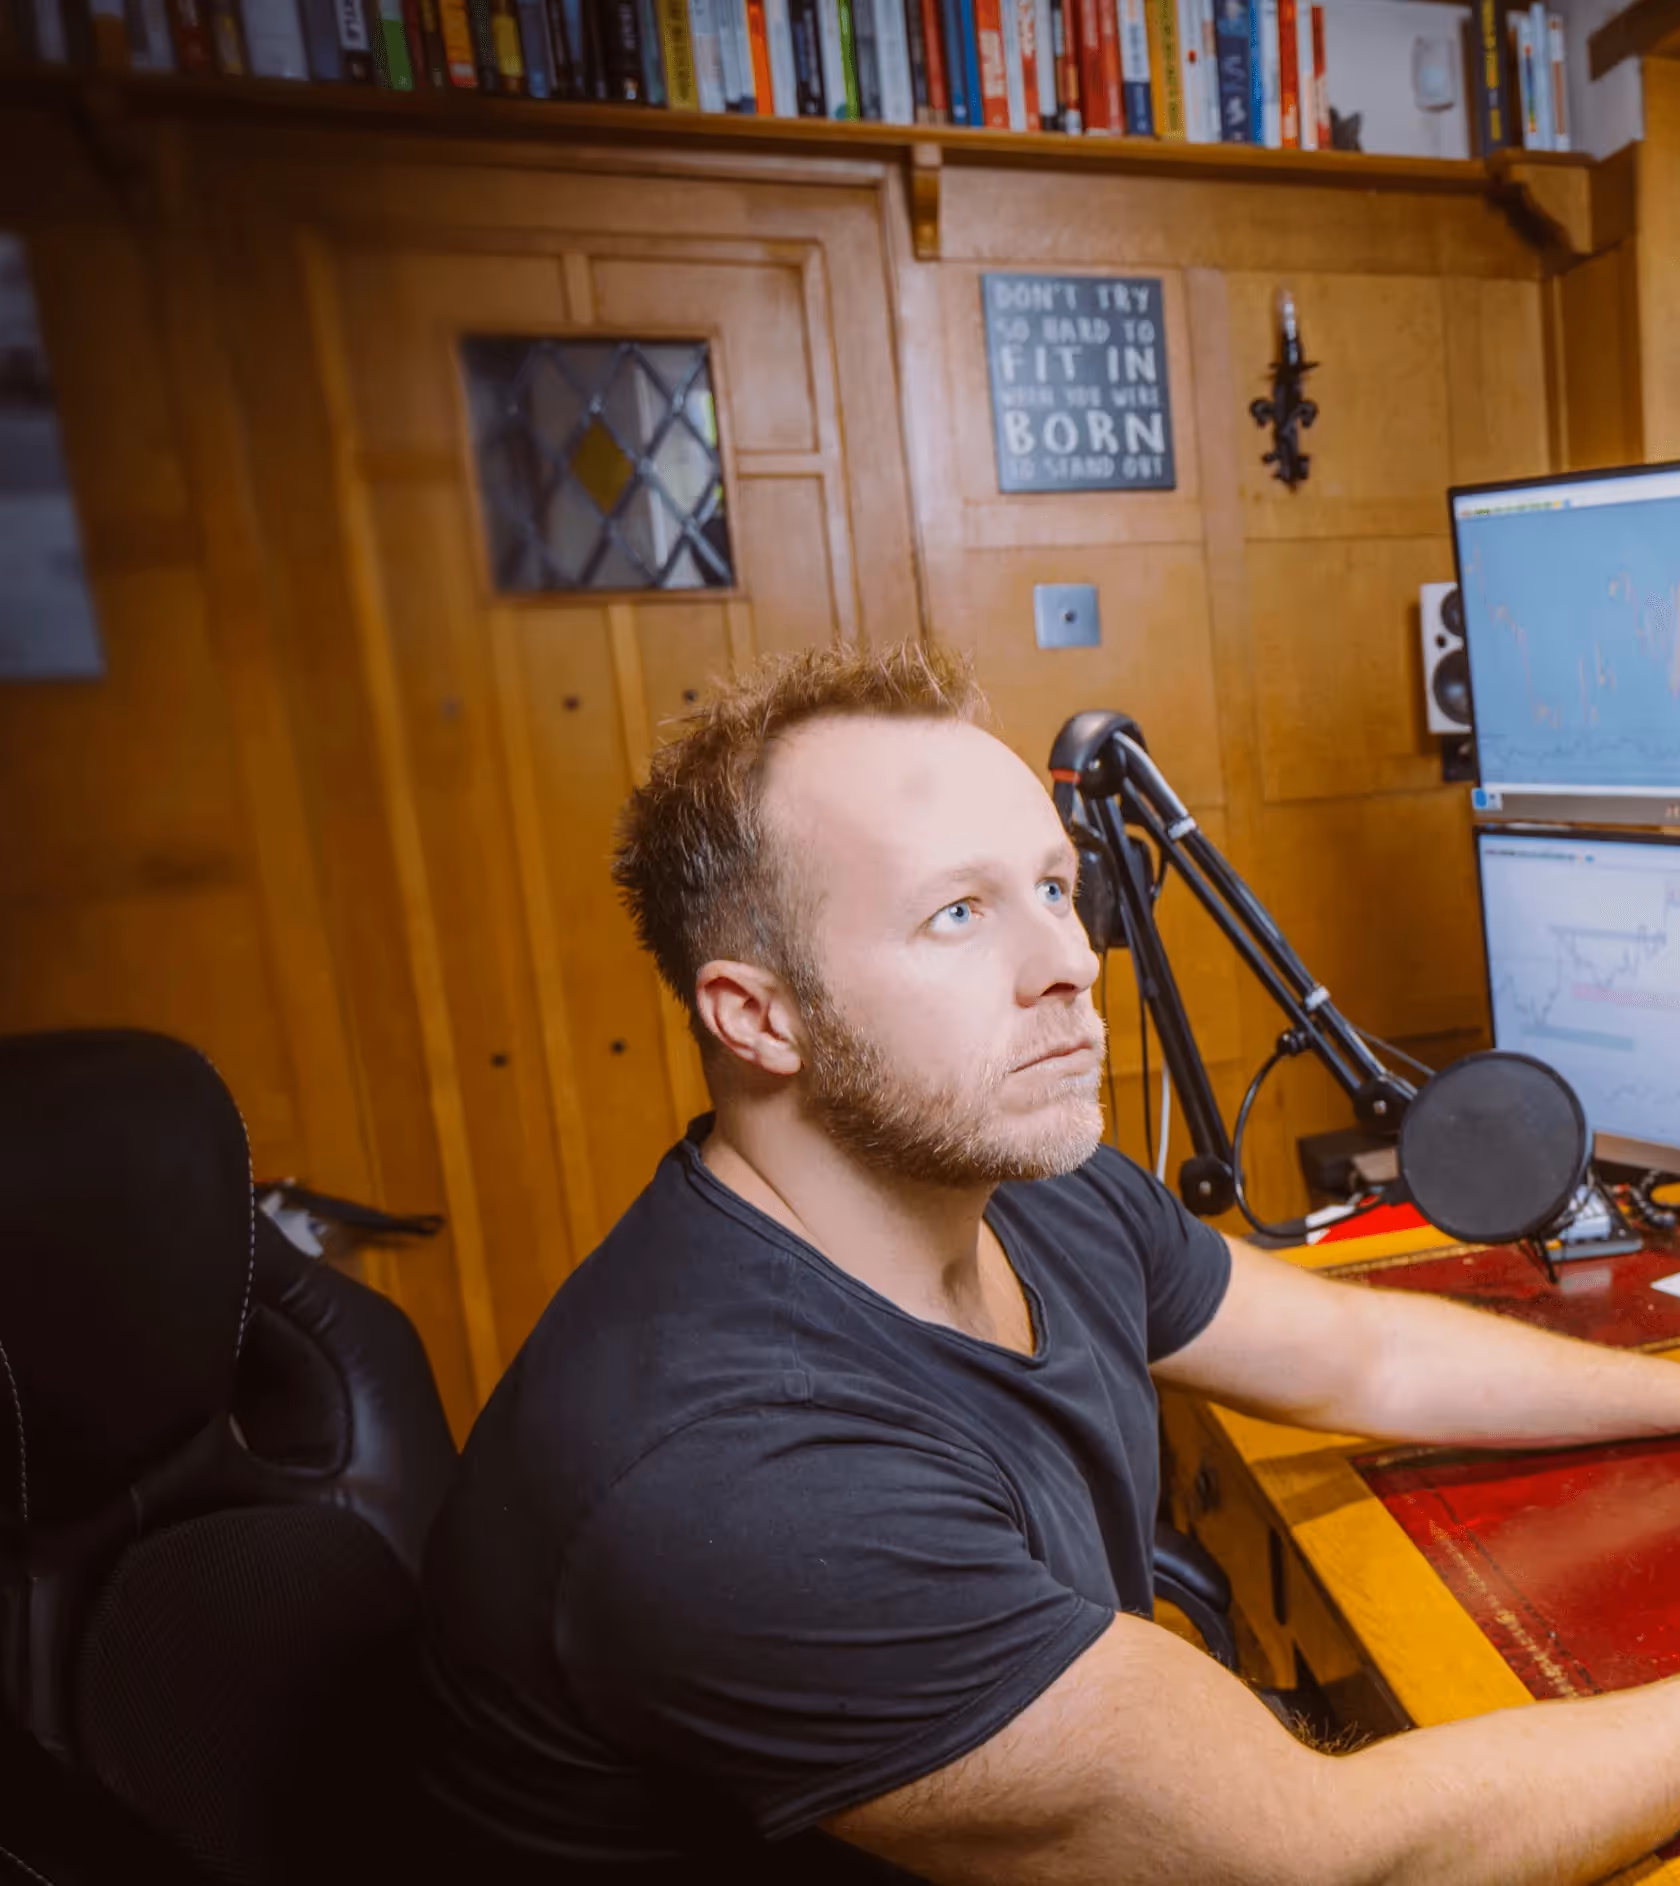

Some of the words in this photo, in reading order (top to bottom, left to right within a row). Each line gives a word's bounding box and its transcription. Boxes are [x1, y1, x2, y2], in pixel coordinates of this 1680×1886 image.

[993, 282, 1078, 311] DON'T
[1097, 283, 1149, 314] TRY
[995, 317, 1030, 343] SO
[1042, 316, 1111, 345] HARD
[1121, 319, 1155, 345] TO
[1000, 345, 1083, 384] FIT
[1106, 345, 1156, 384] IN
[1004, 410, 1165, 454] BORN
[1043, 455, 1115, 479] STAND
[1122, 455, 1162, 479] OUT
